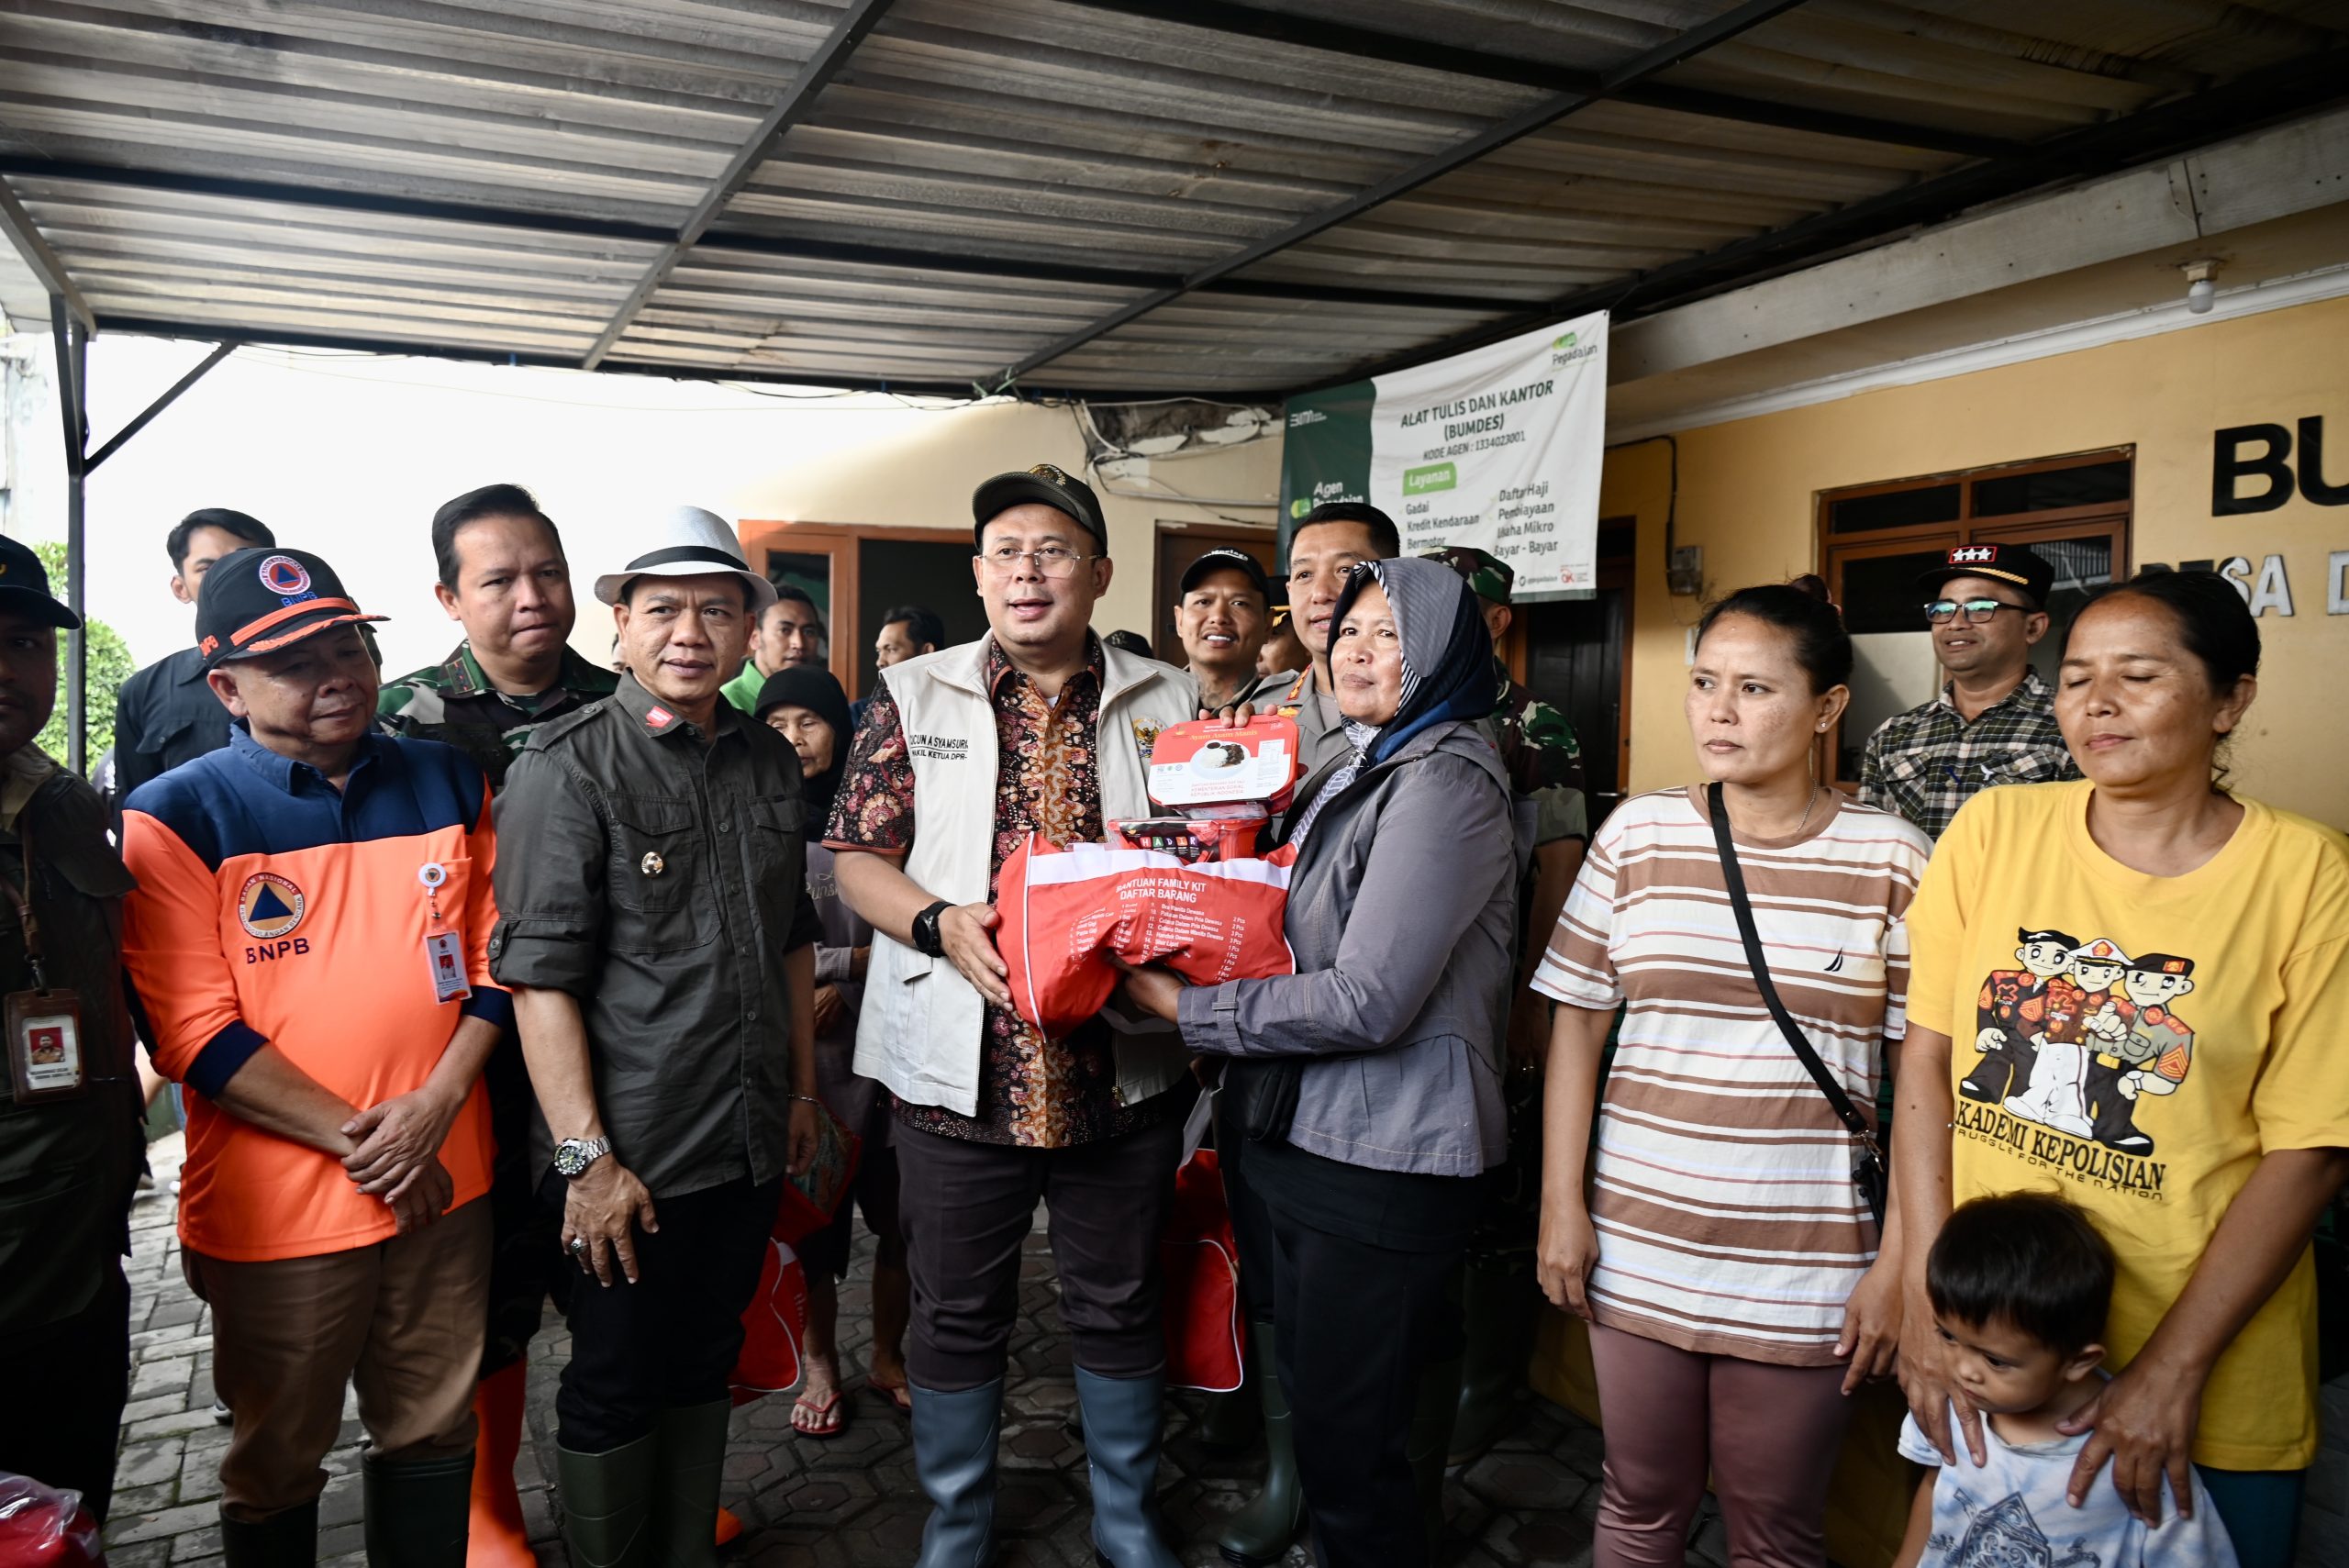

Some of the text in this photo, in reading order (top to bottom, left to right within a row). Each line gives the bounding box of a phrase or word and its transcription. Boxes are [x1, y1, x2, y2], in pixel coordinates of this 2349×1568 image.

[1400, 379, 1554, 428] ALAT TULIS DAN KANTOR
[1443, 413, 1505, 442] (BUMDES)
[1422, 444, 1445, 462] KODE
[1445, 440, 1469, 458] AGEN
[1475, 430, 1526, 451] 1334023001
[2211, 414, 2349, 517] BU
[1408, 469, 1451, 489] Layanan
[1313, 481, 1343, 498] Agen
[1498, 481, 1549, 503] Daftar Haji
[1406, 500, 1431, 516] Gadai
[1497, 502, 1555, 520] Pembiayaan
[1407, 513, 1480, 533] Kredit Kendaraan
[1523, 520, 1555, 535] Mikro
[1407, 536, 1446, 550] Bermotor
[1529, 540, 1559, 556] Bayar
[281, 591, 318, 606] BNPB
[929, 736, 935, 747] A
[928, 750, 950, 760] KETUA
[1141, 836, 1196, 847] HADIR
[1116, 877, 1207, 893] BANTUAN FAMILY KIT
[1119, 888, 1197, 903] DAFTAR BARANG
[245, 938, 310, 964] BNPB
[1954, 1100, 2166, 1192] KADEMI KEPOLISIAN
[1954, 1125, 2013, 1155] RUGGLE
[2018, 1152, 2048, 1171] FOR
[2054, 1166, 2086, 1184] THE
